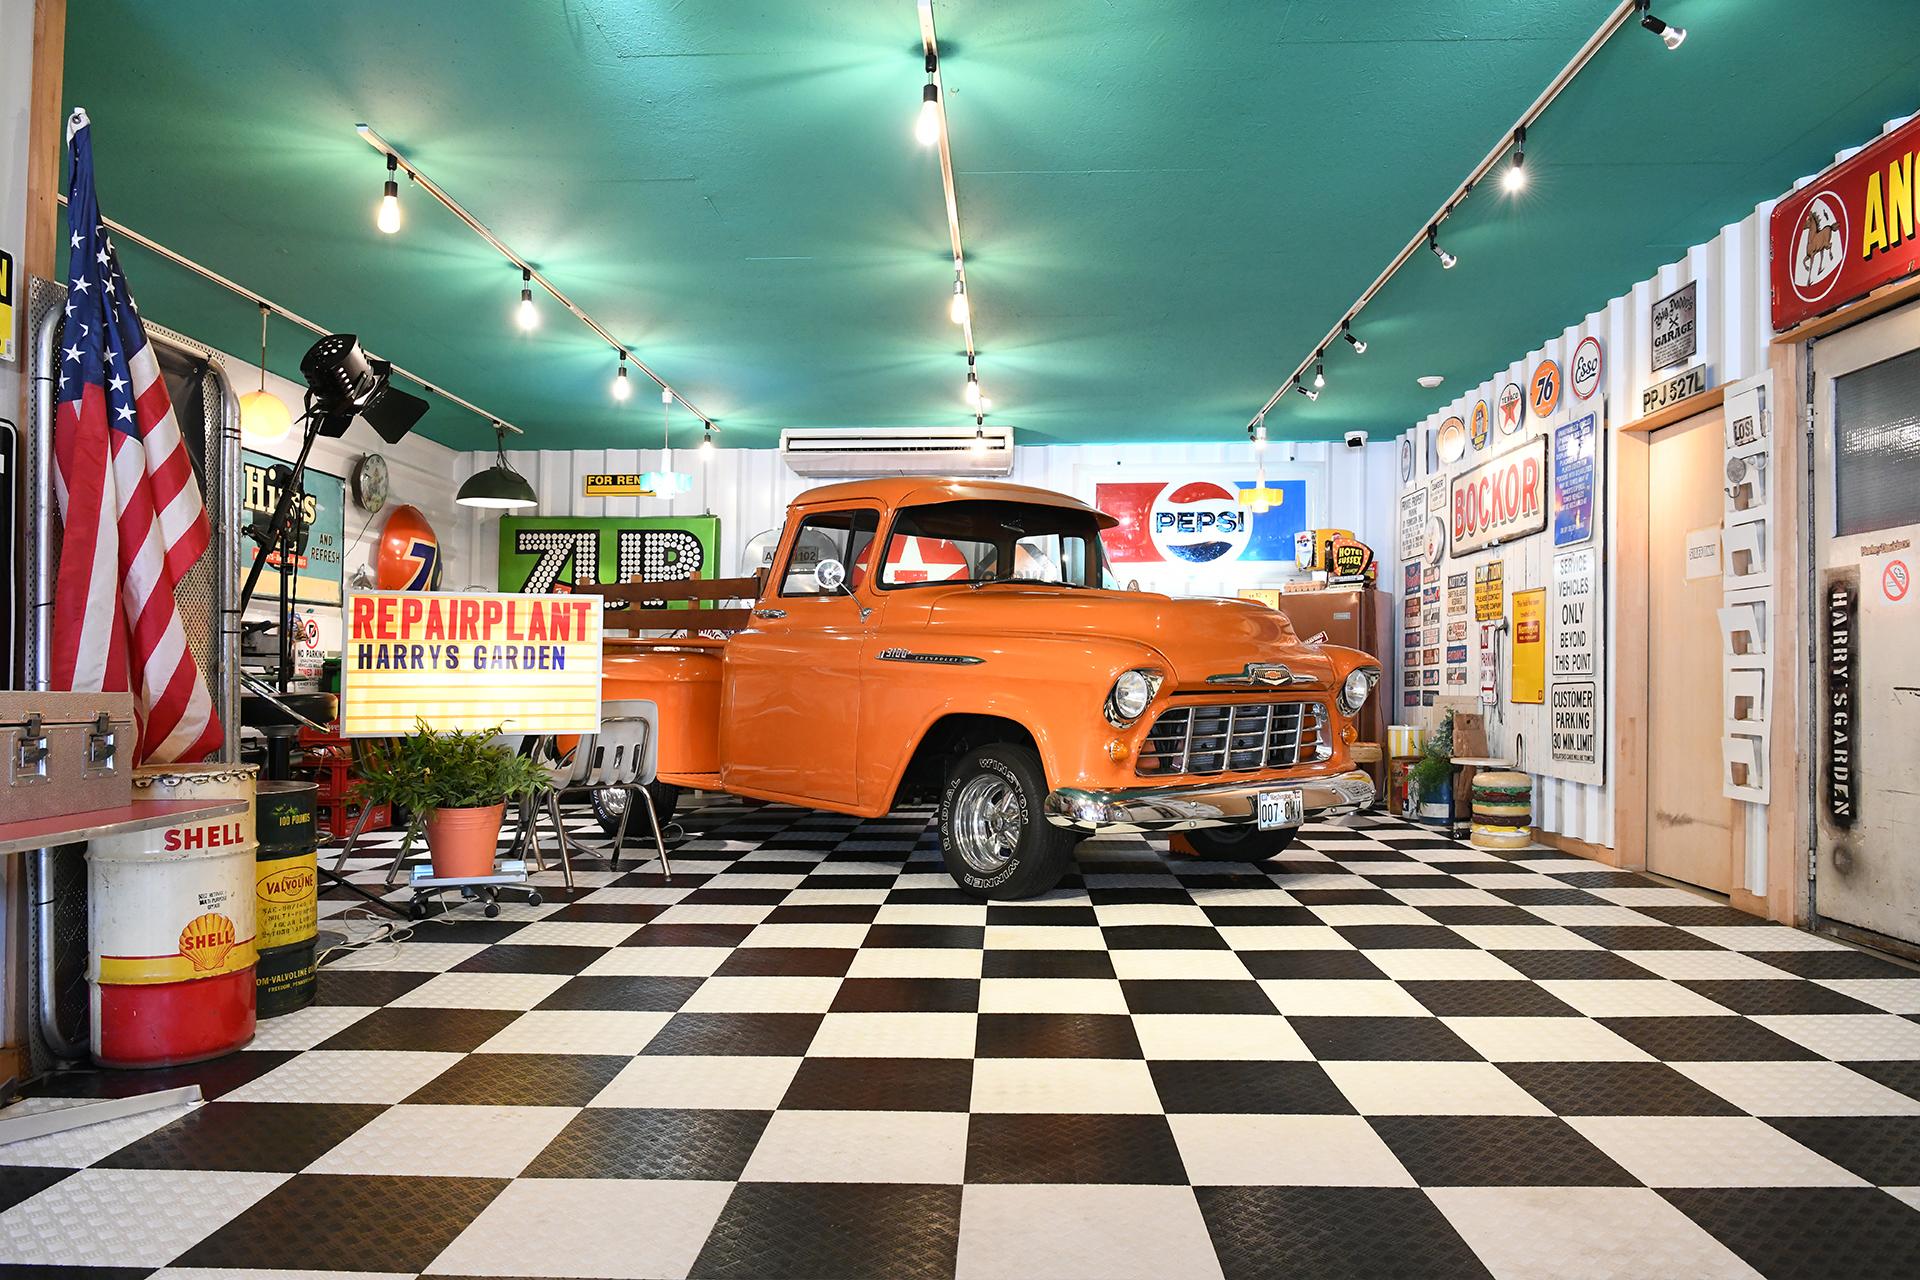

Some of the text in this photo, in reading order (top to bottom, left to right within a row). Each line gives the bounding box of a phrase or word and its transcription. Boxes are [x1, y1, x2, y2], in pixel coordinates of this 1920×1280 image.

[1655, 320, 1693, 347] GARAGE
[1575, 357, 1598, 384] Esso
[1501, 392, 1519, 404] TEXACO
[1535, 372, 1553, 406] 76
[1643, 371, 1705, 412] PPJ 527L
[587, 475, 641, 486] FOR REN
[1455, 457, 1539, 541] BOCKOR
[1157, 511, 1245, 533] PEPSI
[320, 534, 333, 546] AND
[311, 547, 340, 564] REFRESH
[1338, 547, 1363, 558] HOTEL
[1338, 556, 1362, 565] SUSSEX
[1560, 554, 1587, 575] SERVICE
[1558, 577, 1589, 597] VEHICLES
[352, 597, 592, 642] REPAIRPLANT
[1562, 602, 1585, 626] ONLY
[1560, 631, 1587, 648] BEYOND
[358, 644, 566, 670] HARRYS GARDEN
[886, 647, 908, 659] 3100
[915, 655, 959, 663] CHEVROLET
[1555, 653, 1591, 671] THIS POINT
[1553, 690, 1593, 708] CUSTOMER
[1832, 592, 1849, 816] HARRY'S GARDEN
[1555, 712, 1590, 730] PARKING
[1553, 733, 1561, 750] 30
[1576, 733, 1593, 752] LIMIT
[979, 758, 1029, 825] WINSTON
[291, 812, 311, 825] POUNDS
[941, 778, 961, 851] RADIAL
[163, 823, 245, 851] SHELL
[963, 859, 1020, 888] WINNER
[266, 873, 313, 896] VALVOLINE
[185, 931, 233, 951] SHELL
